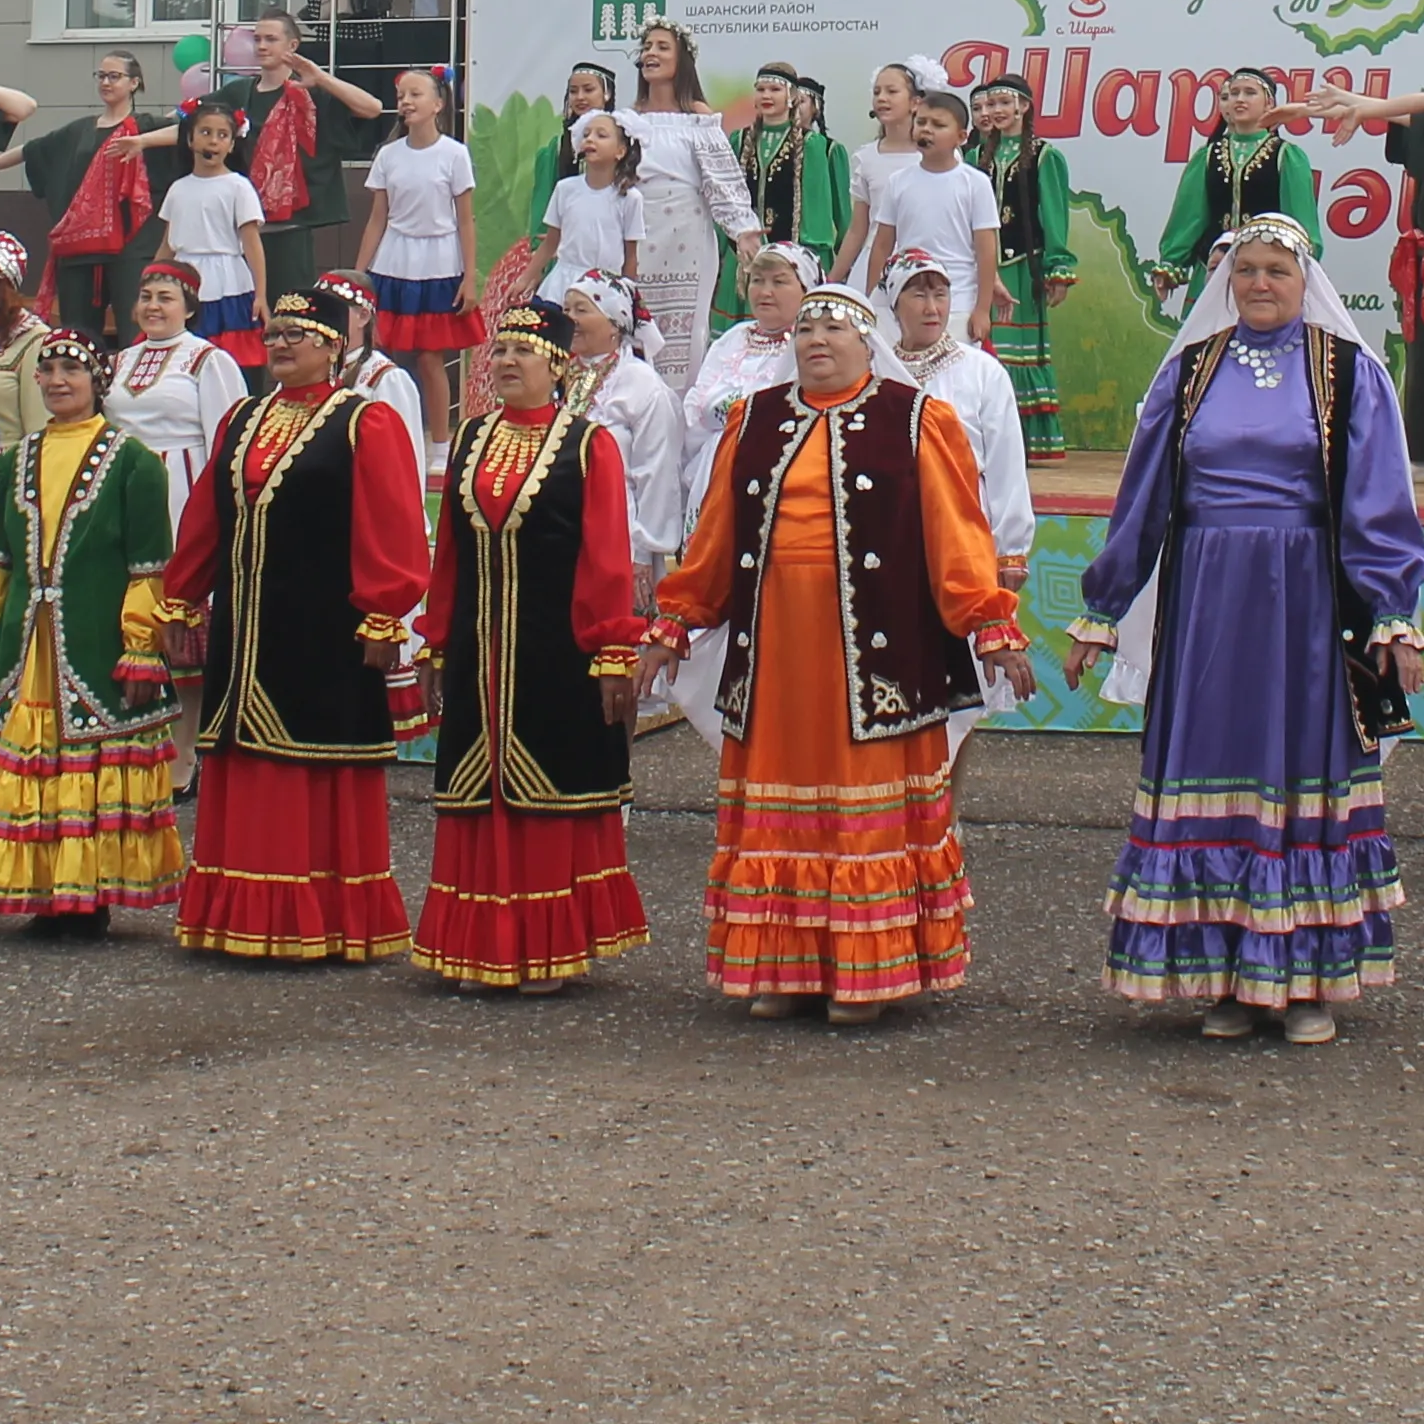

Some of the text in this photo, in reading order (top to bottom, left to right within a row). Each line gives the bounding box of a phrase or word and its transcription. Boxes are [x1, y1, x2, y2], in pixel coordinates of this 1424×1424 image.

[685, 2, 815, 17] ШАРАНСКИЙ РАЙОН
[772, 19, 879, 33] БАШКОРТОСТАН
[1068, 21, 1116, 41] Шаран
